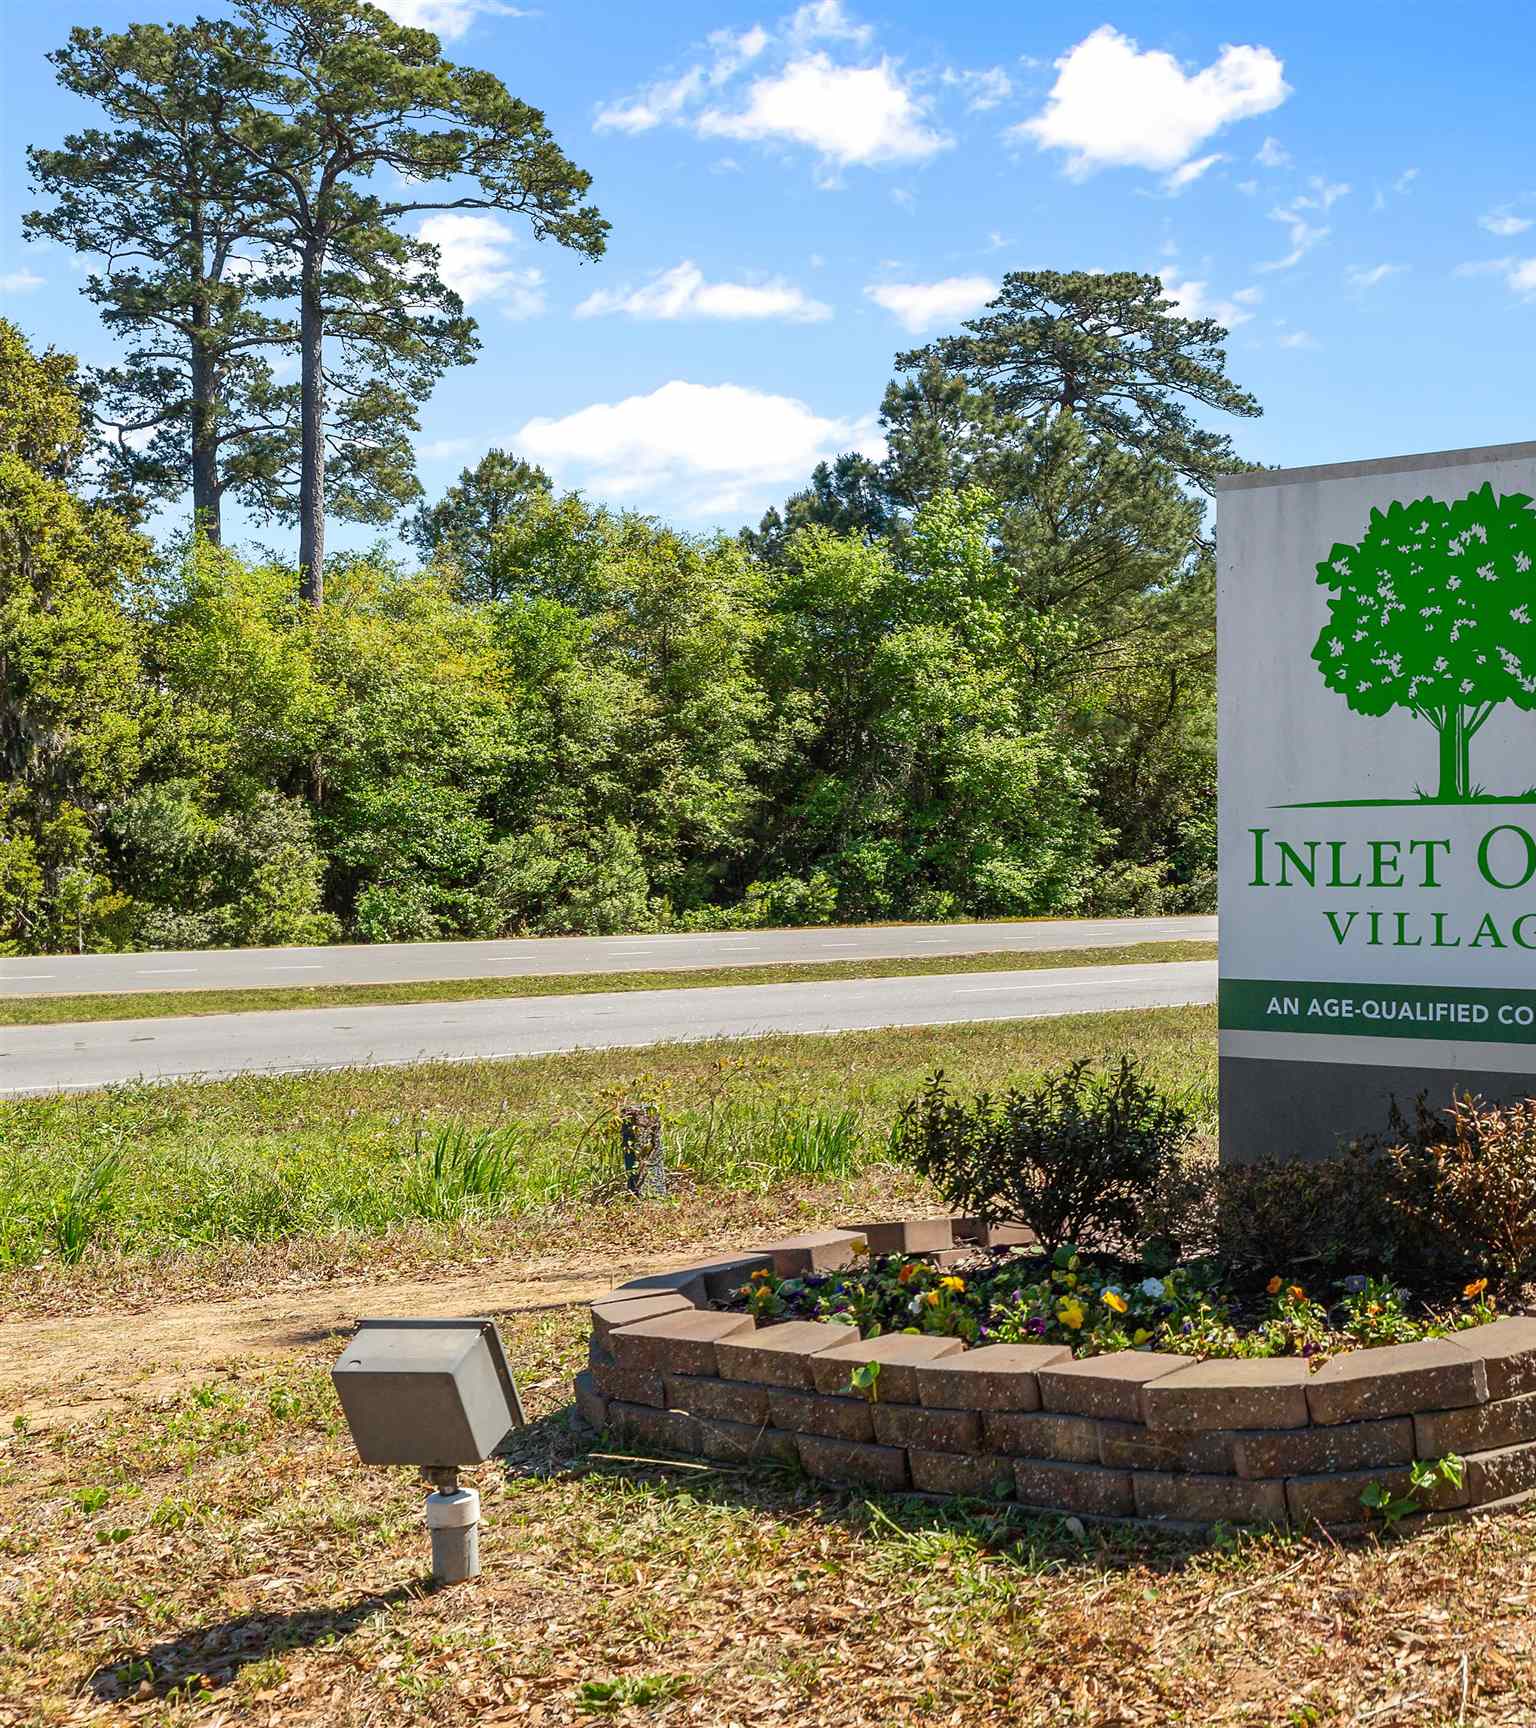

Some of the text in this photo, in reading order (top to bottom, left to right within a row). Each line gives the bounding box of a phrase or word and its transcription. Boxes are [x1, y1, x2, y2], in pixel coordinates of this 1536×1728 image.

[1248, 827, 1451, 888] INLET
[1266, 996, 1299, 1015] AN
[1307, 998, 1489, 1023] AGE-QUALIFIED
